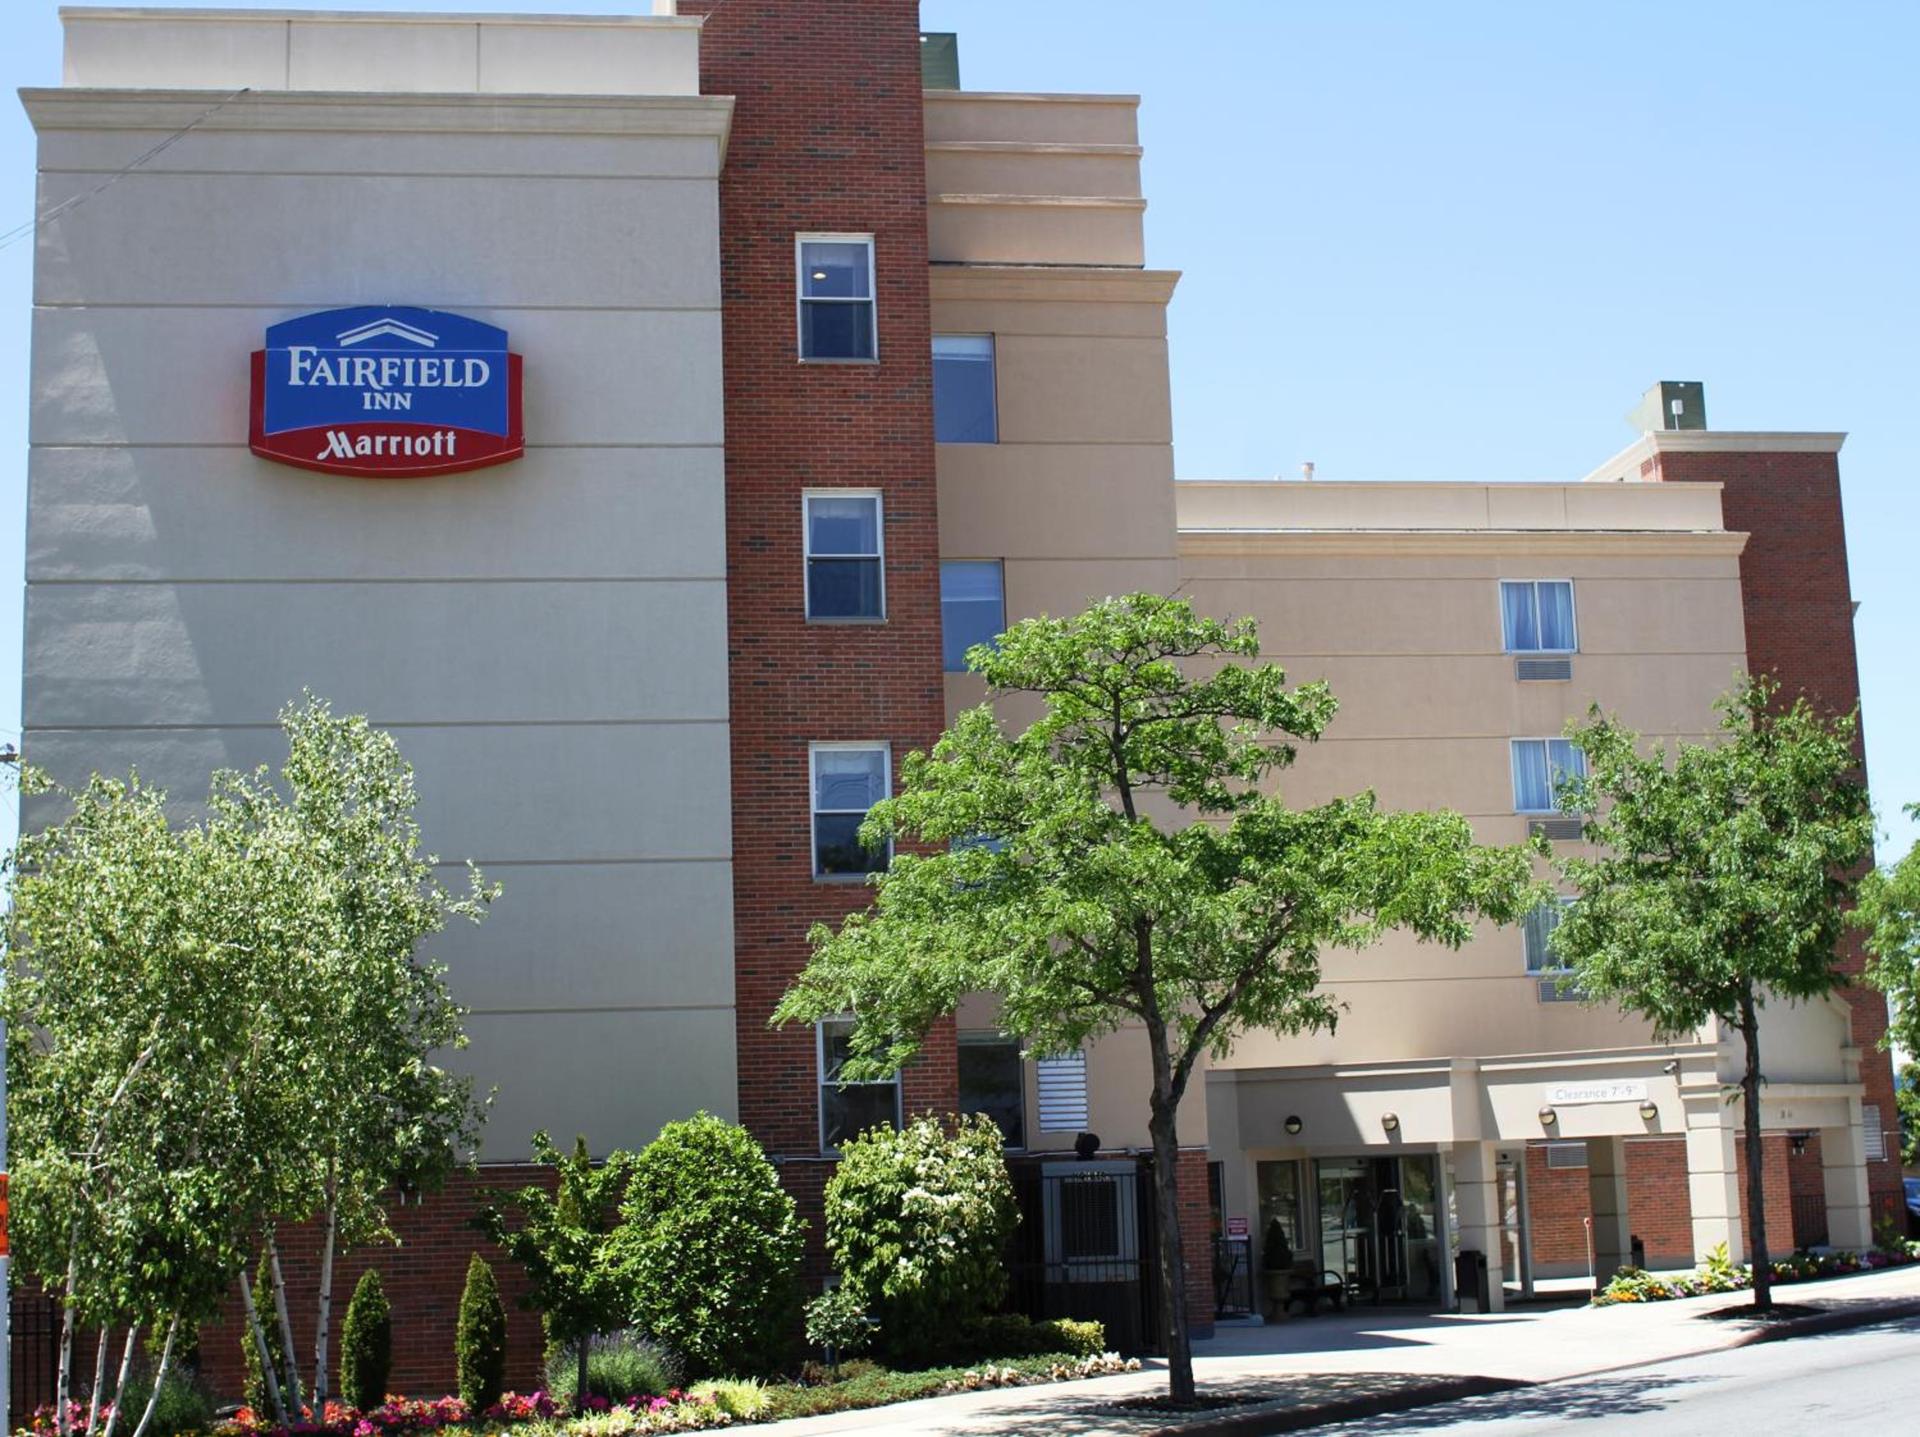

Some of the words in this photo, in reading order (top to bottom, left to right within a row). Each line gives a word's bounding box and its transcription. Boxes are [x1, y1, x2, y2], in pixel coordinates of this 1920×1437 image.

[287, 346, 490, 390] FAIRFIELD
[363, 392, 412, 410] INN
[316, 430, 457, 461] Marriott
[1555, 1087, 1608, 1100] Clearance
